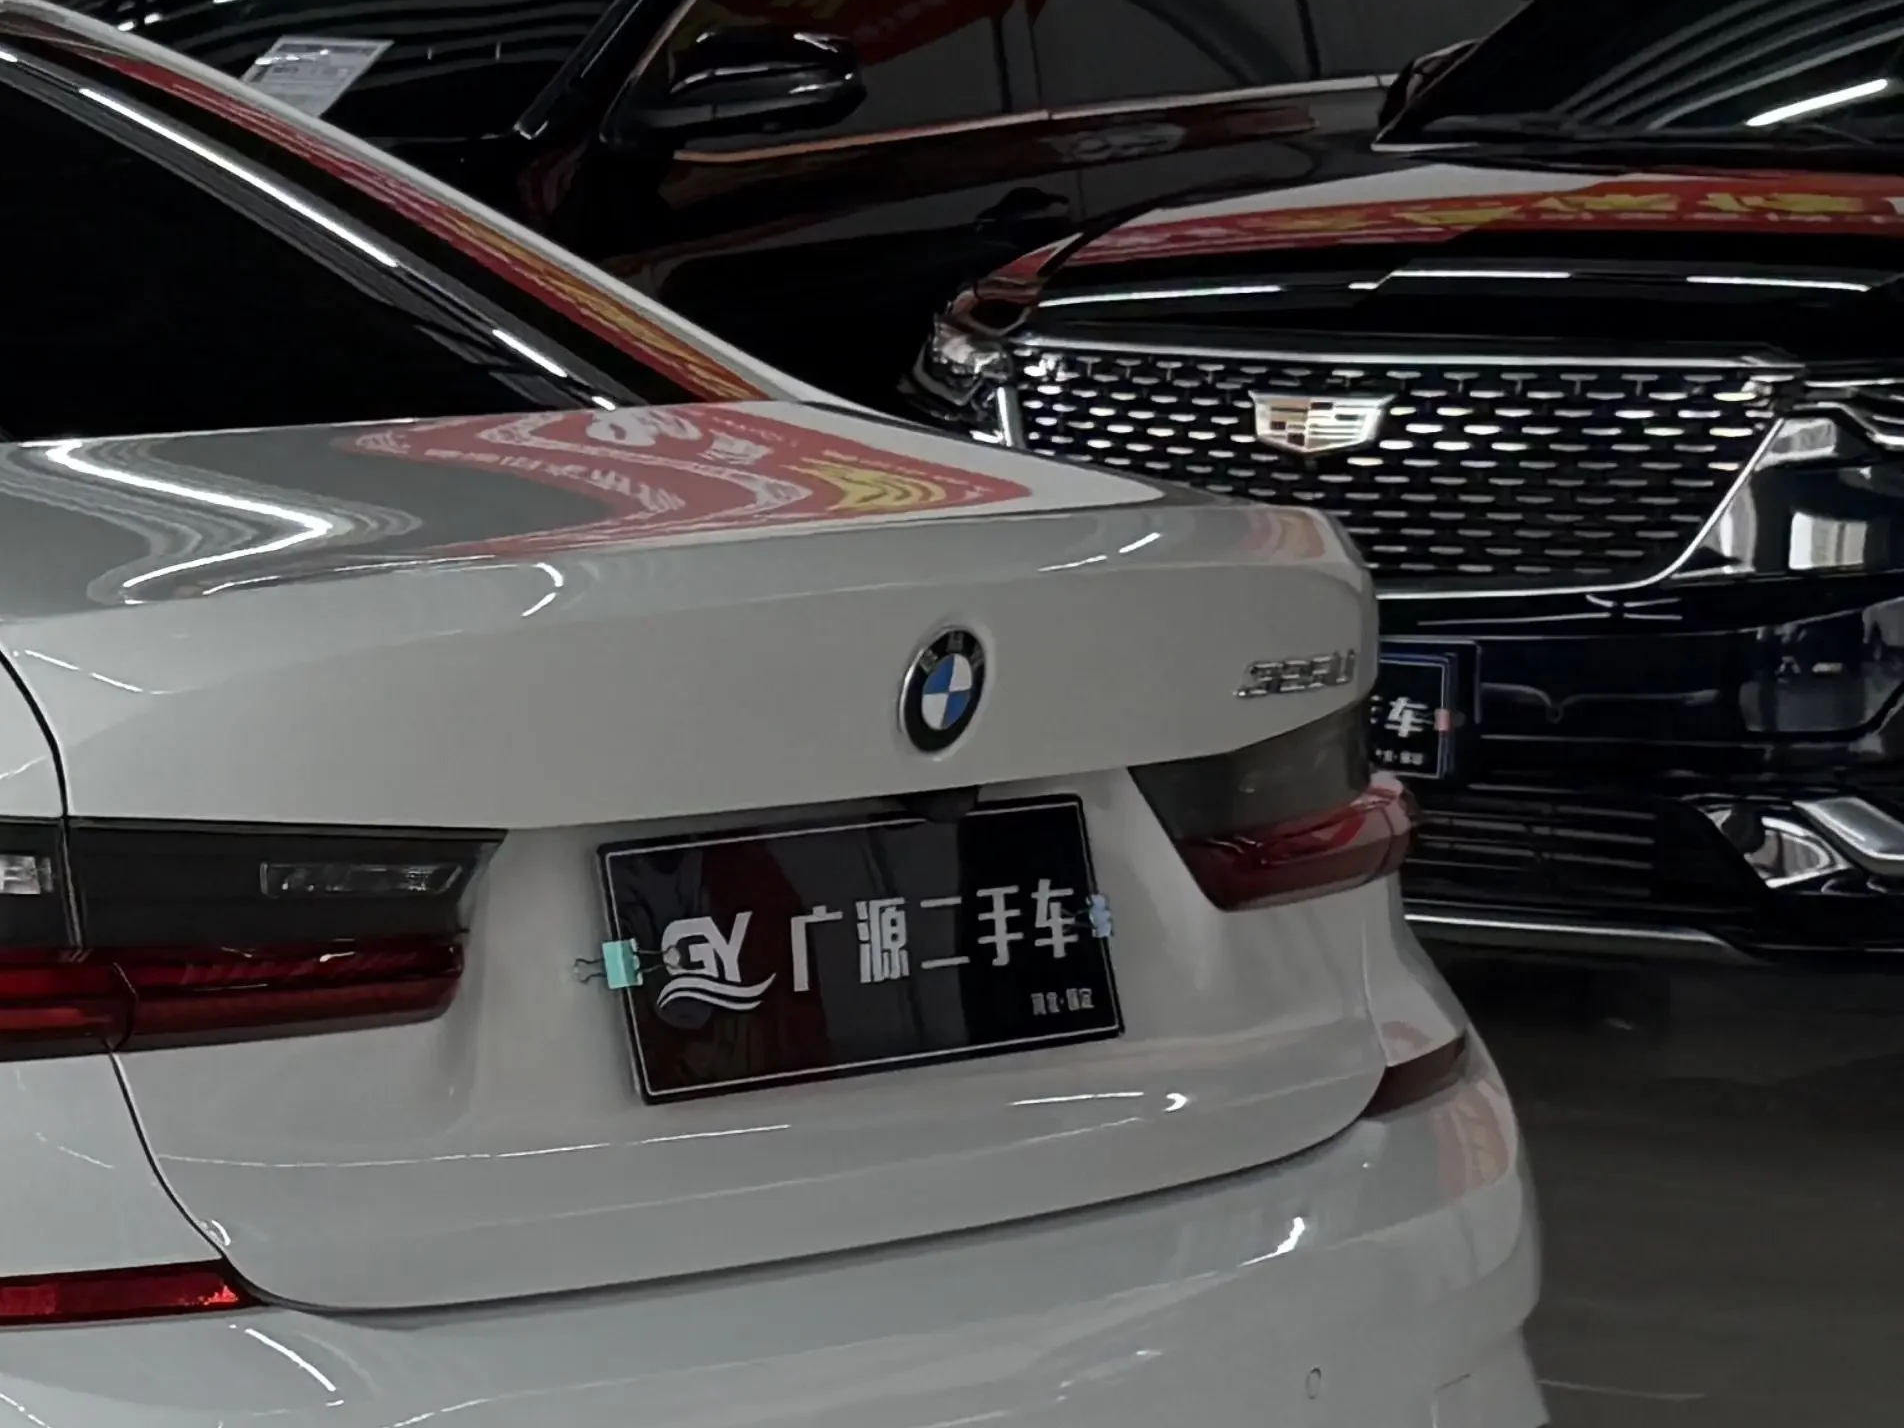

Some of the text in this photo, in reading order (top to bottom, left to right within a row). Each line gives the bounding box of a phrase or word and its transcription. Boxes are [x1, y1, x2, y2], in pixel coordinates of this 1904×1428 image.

[790, 879, 1079, 992] 广源二手车
